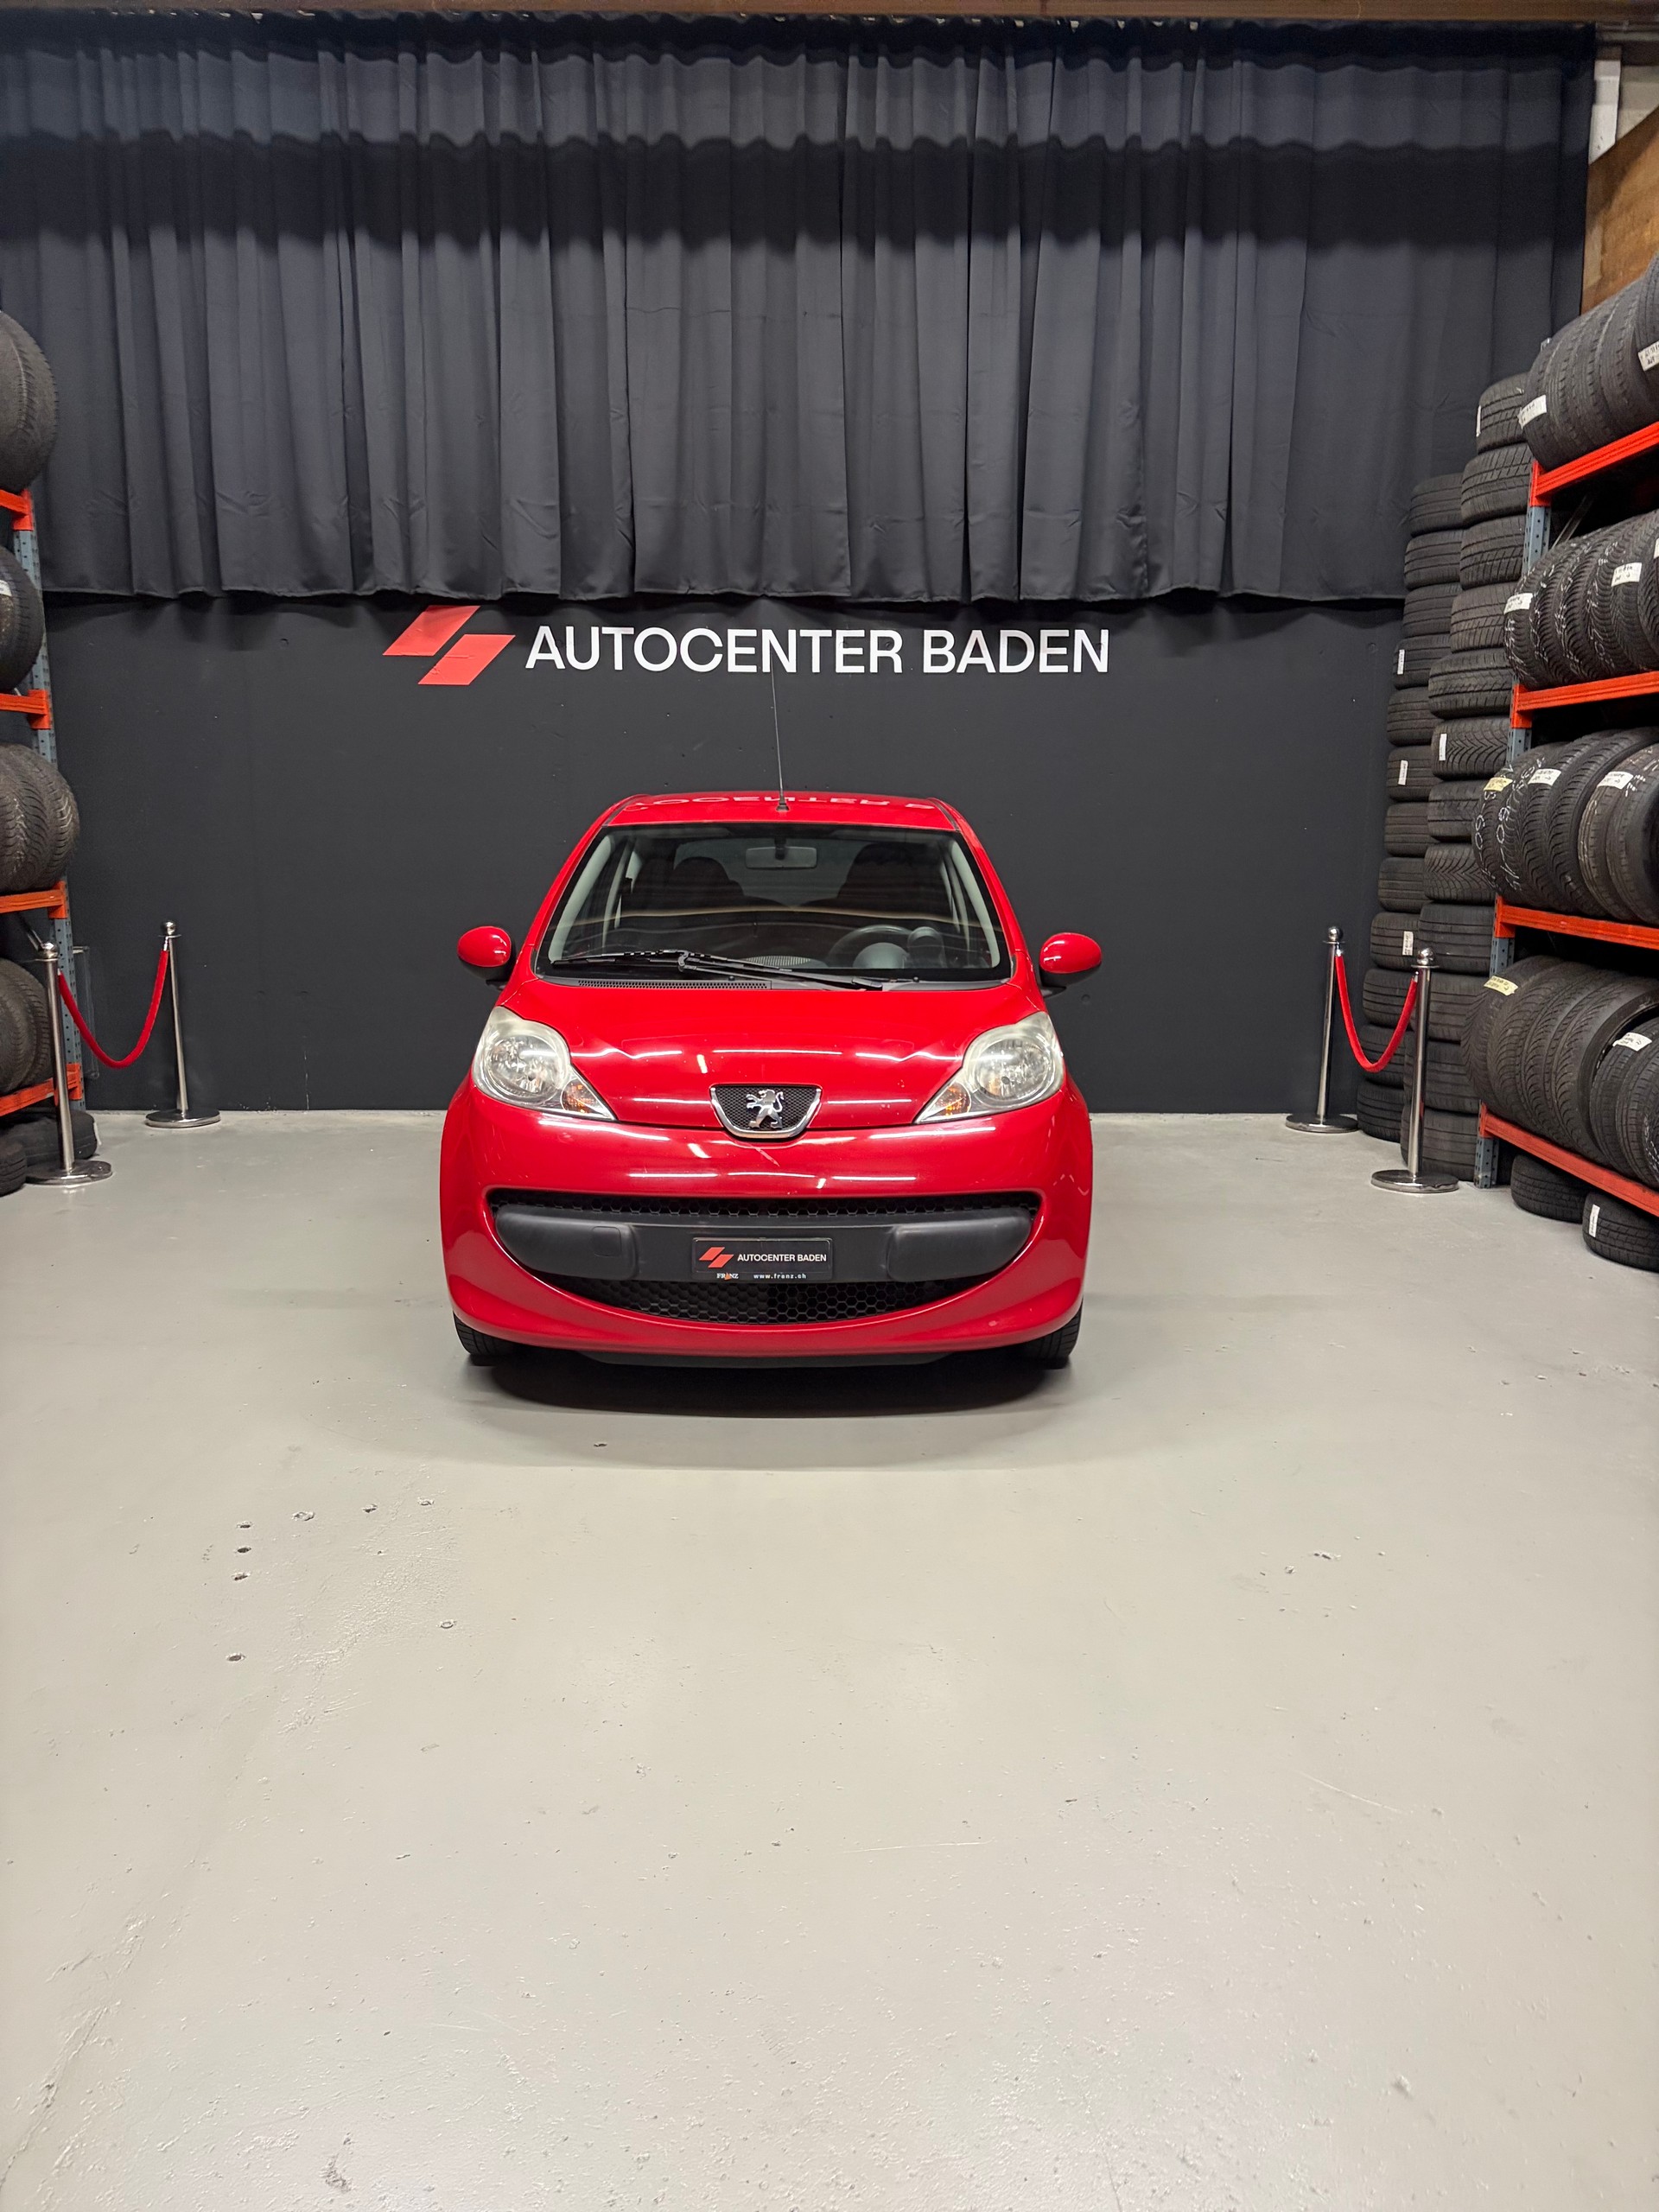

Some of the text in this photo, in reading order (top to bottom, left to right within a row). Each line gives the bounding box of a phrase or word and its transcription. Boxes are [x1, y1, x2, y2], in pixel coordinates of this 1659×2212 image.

[524, 626, 1109, 673] AUTOCENTER BADEN
[737, 1253, 827, 1262] AUTOCENTER BADEN
